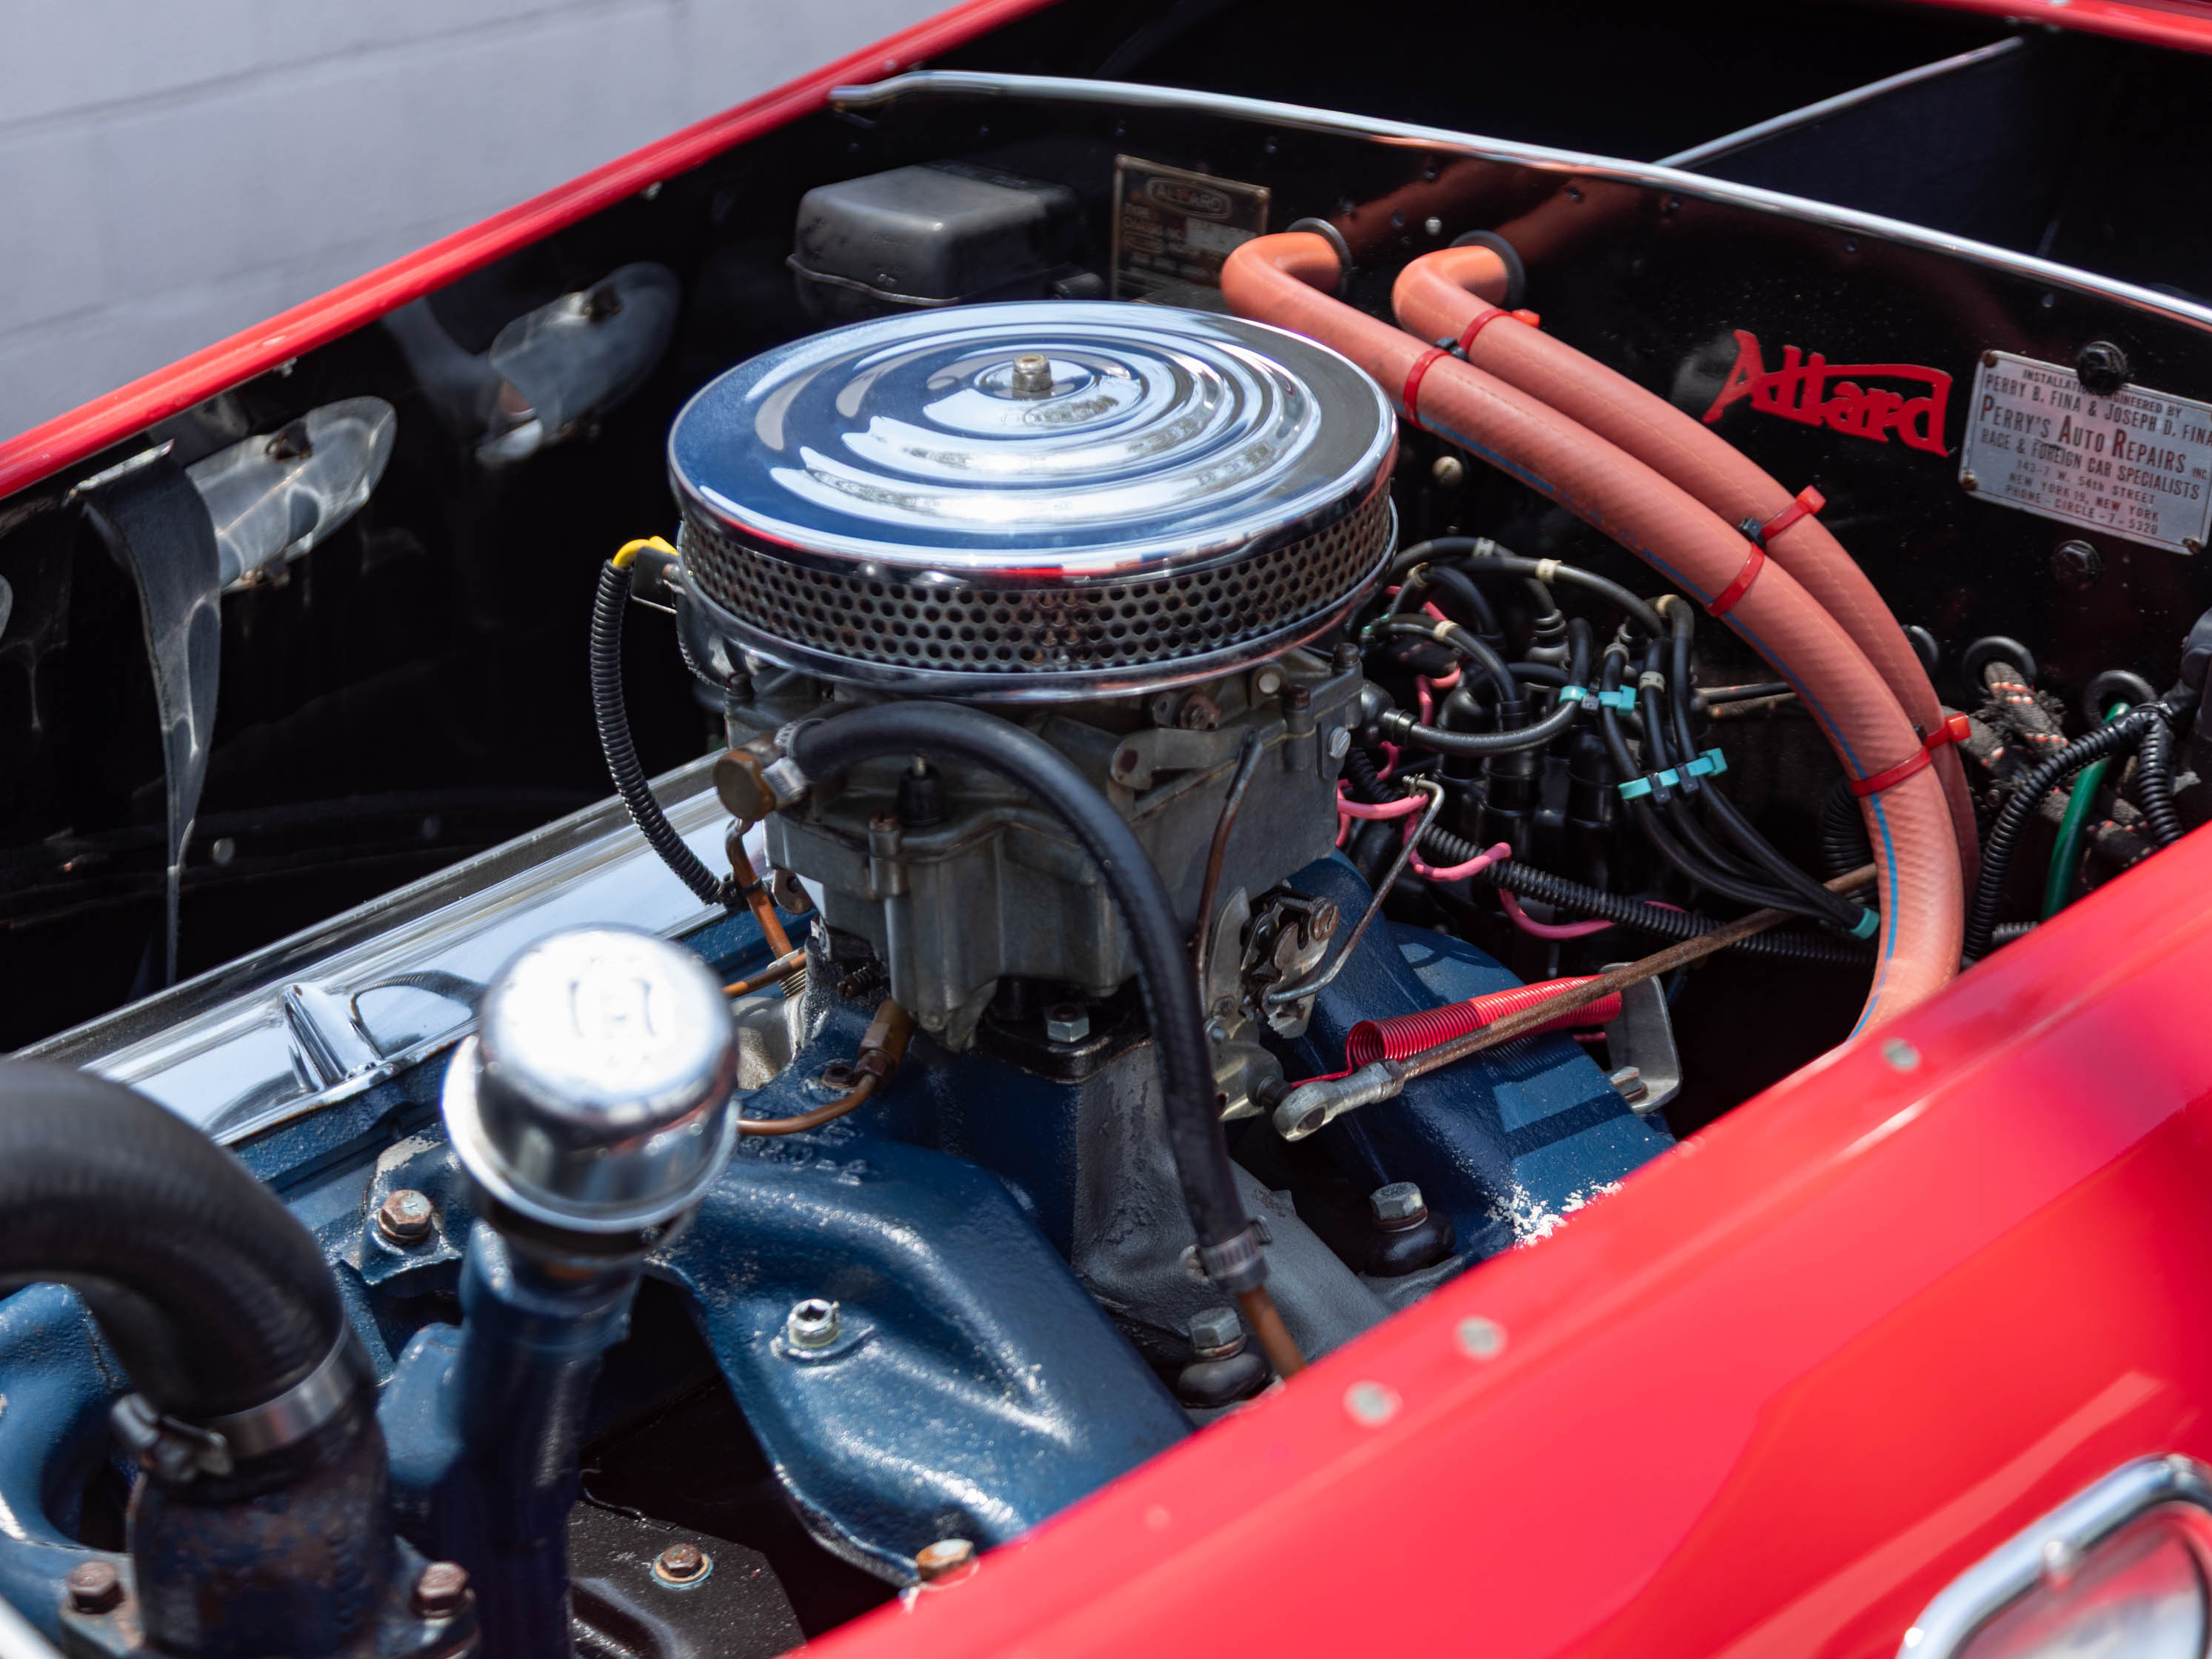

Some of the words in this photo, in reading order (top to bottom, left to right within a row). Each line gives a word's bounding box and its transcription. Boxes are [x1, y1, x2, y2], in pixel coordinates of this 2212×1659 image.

[1985, 373, 2026, 398] PERRY
[2032, 386, 2044, 403] B.
[2051, 390, 2082, 412] FINA
[2087, 400, 2097, 418] &
[2105, 404, 2158, 432] JOSEPH
[2163, 419, 2176, 437] D.
[2022, 369, 2094, 395] INSTALLATI
[2102, 390, 2163, 413] GINEERED
[2167, 405, 2182, 418] BY
[1979, 394, 2052, 438] PERRY'S
[2058, 415, 2105, 453] AUTO
[2111, 428, 2187, 474] REPAIRS
[1980, 428, 2011, 450] RACE
[2016, 438, 2026, 455] &
[2031, 441, 2083, 469] FOREIGN
[2088, 457, 2112, 478] CAR
[2117, 465, 2200, 500] SPECIALISTS
[2005, 484, 2042, 503] PHONE
[2054, 498, 2096, 518] CIRCLE
[2008, 472, 2034, 487] NEW
[2041, 480, 2070, 498] YORK
[2095, 496, 2122, 511] NEW
[2128, 504, 2160, 522] YORK
[2111, 485, 2157, 505] STREET
